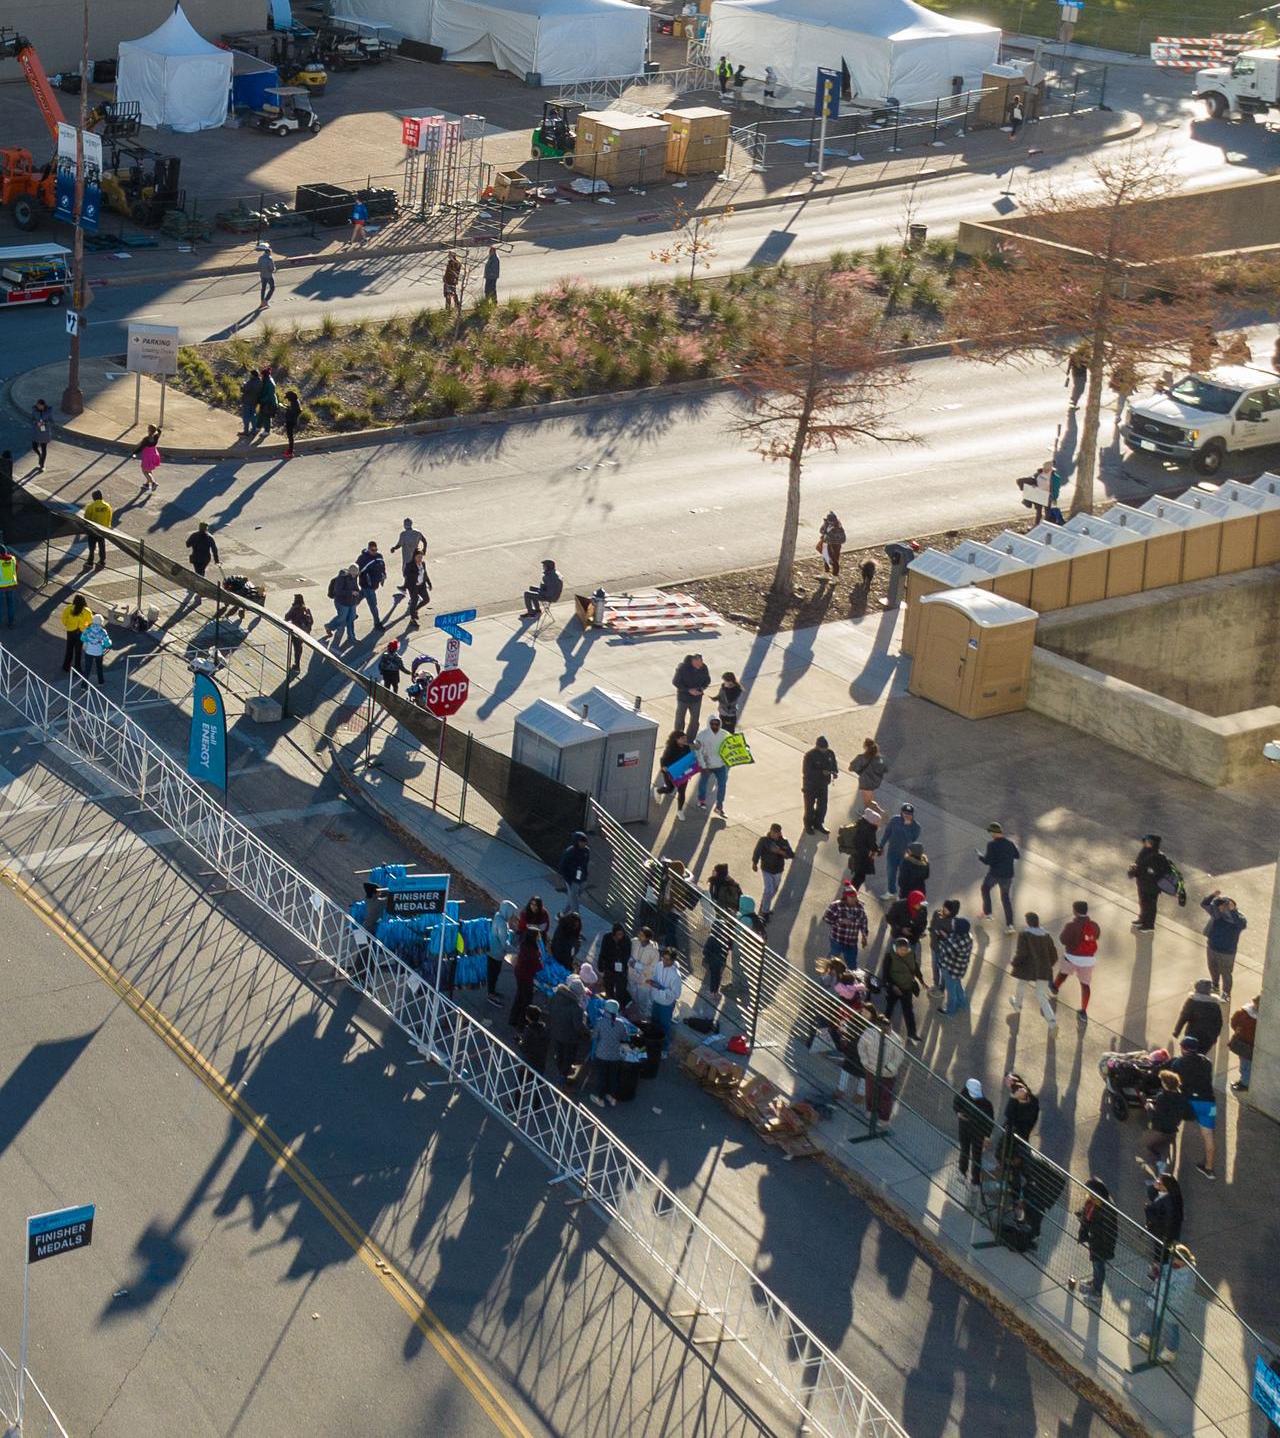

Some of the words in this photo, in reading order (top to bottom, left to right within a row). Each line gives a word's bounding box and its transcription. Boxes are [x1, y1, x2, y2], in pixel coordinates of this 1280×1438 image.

[142, 337, 171, 347] PARKING
[429, 682, 467, 704] STOP
[200, 722, 210, 768] ENERGY
[393, 892, 440, 901] FINISHER
[394, 902, 436, 911] MEDALS
[35, 1223, 86, 1246] FINISHER
[37, 1235, 82, 1257] MEDALS
